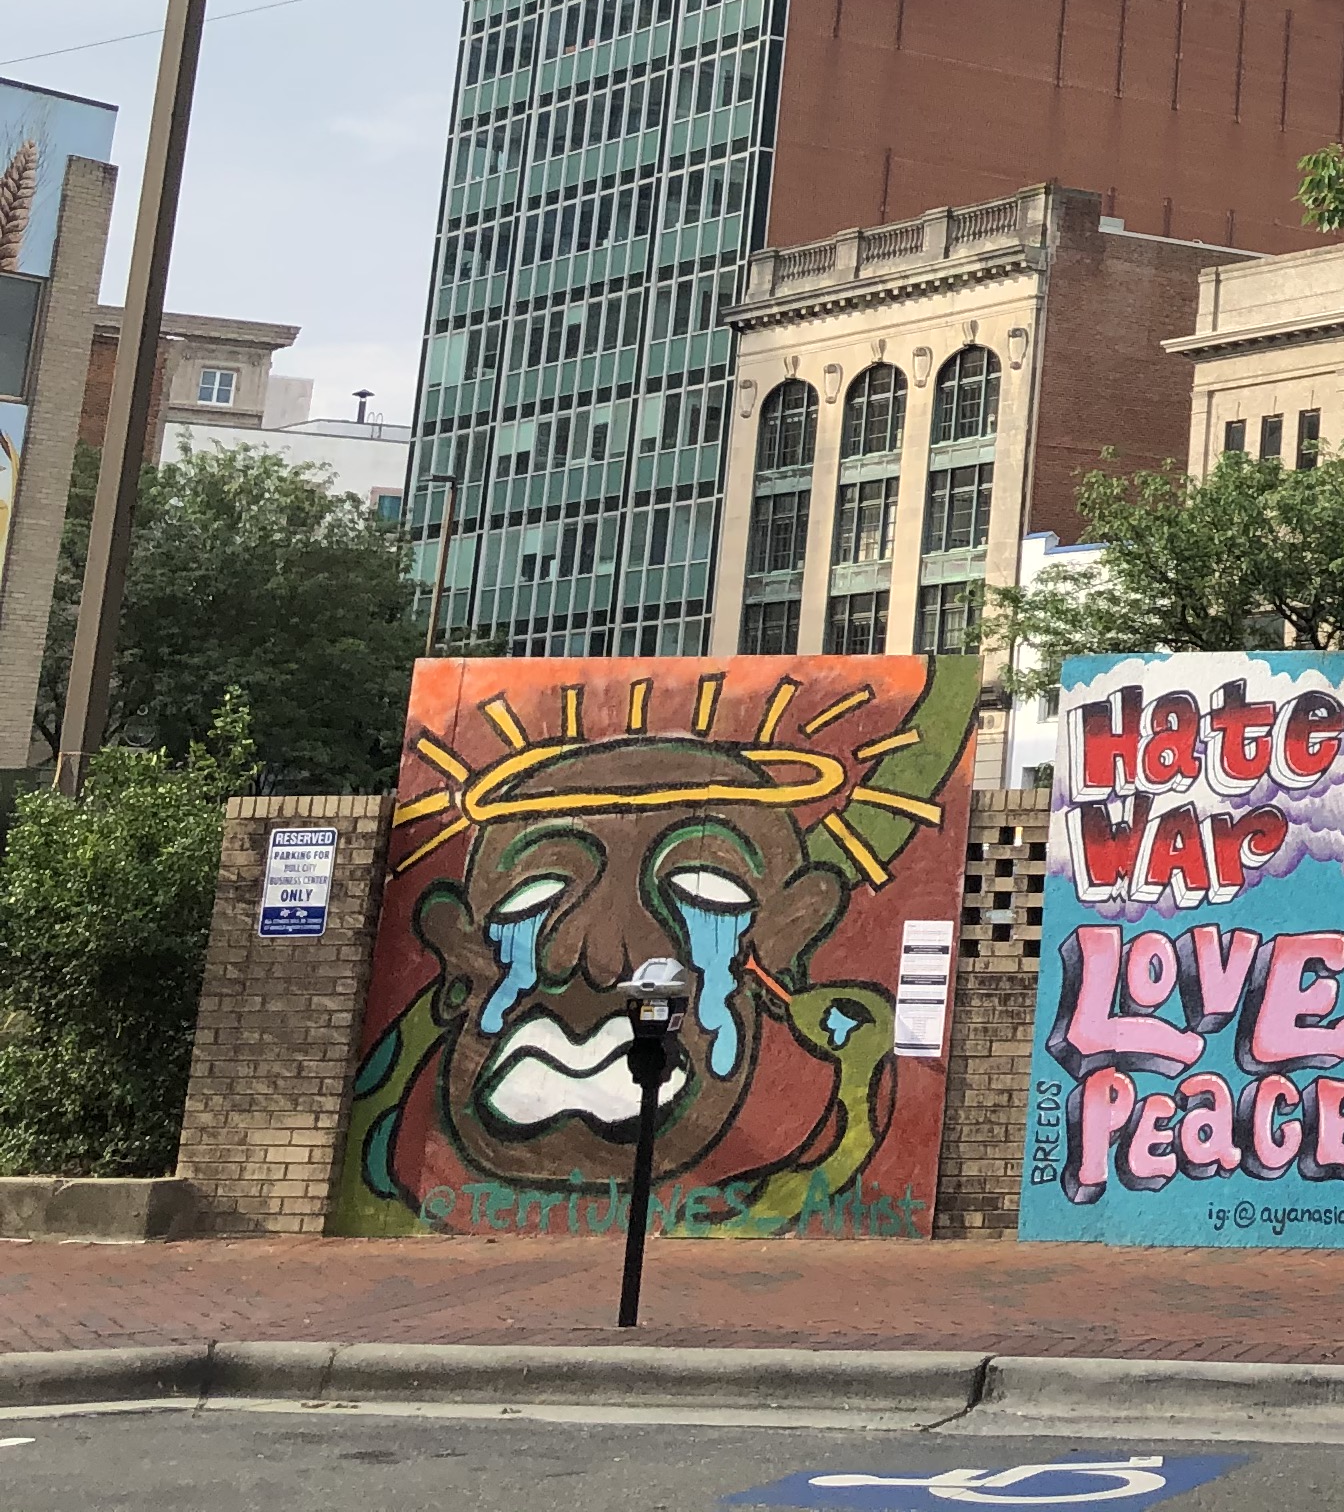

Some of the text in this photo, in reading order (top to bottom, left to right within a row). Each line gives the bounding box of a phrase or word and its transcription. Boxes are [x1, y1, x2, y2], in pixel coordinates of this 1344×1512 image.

[275, 832, 332, 844] RESERVED
[274, 851, 330, 860] PARKING FOR
[269, 876, 328, 885] BUSINESS CENTER
[280, 889, 313, 902] ONLY
[1031, 1080, 1062, 1186] BREEDS
